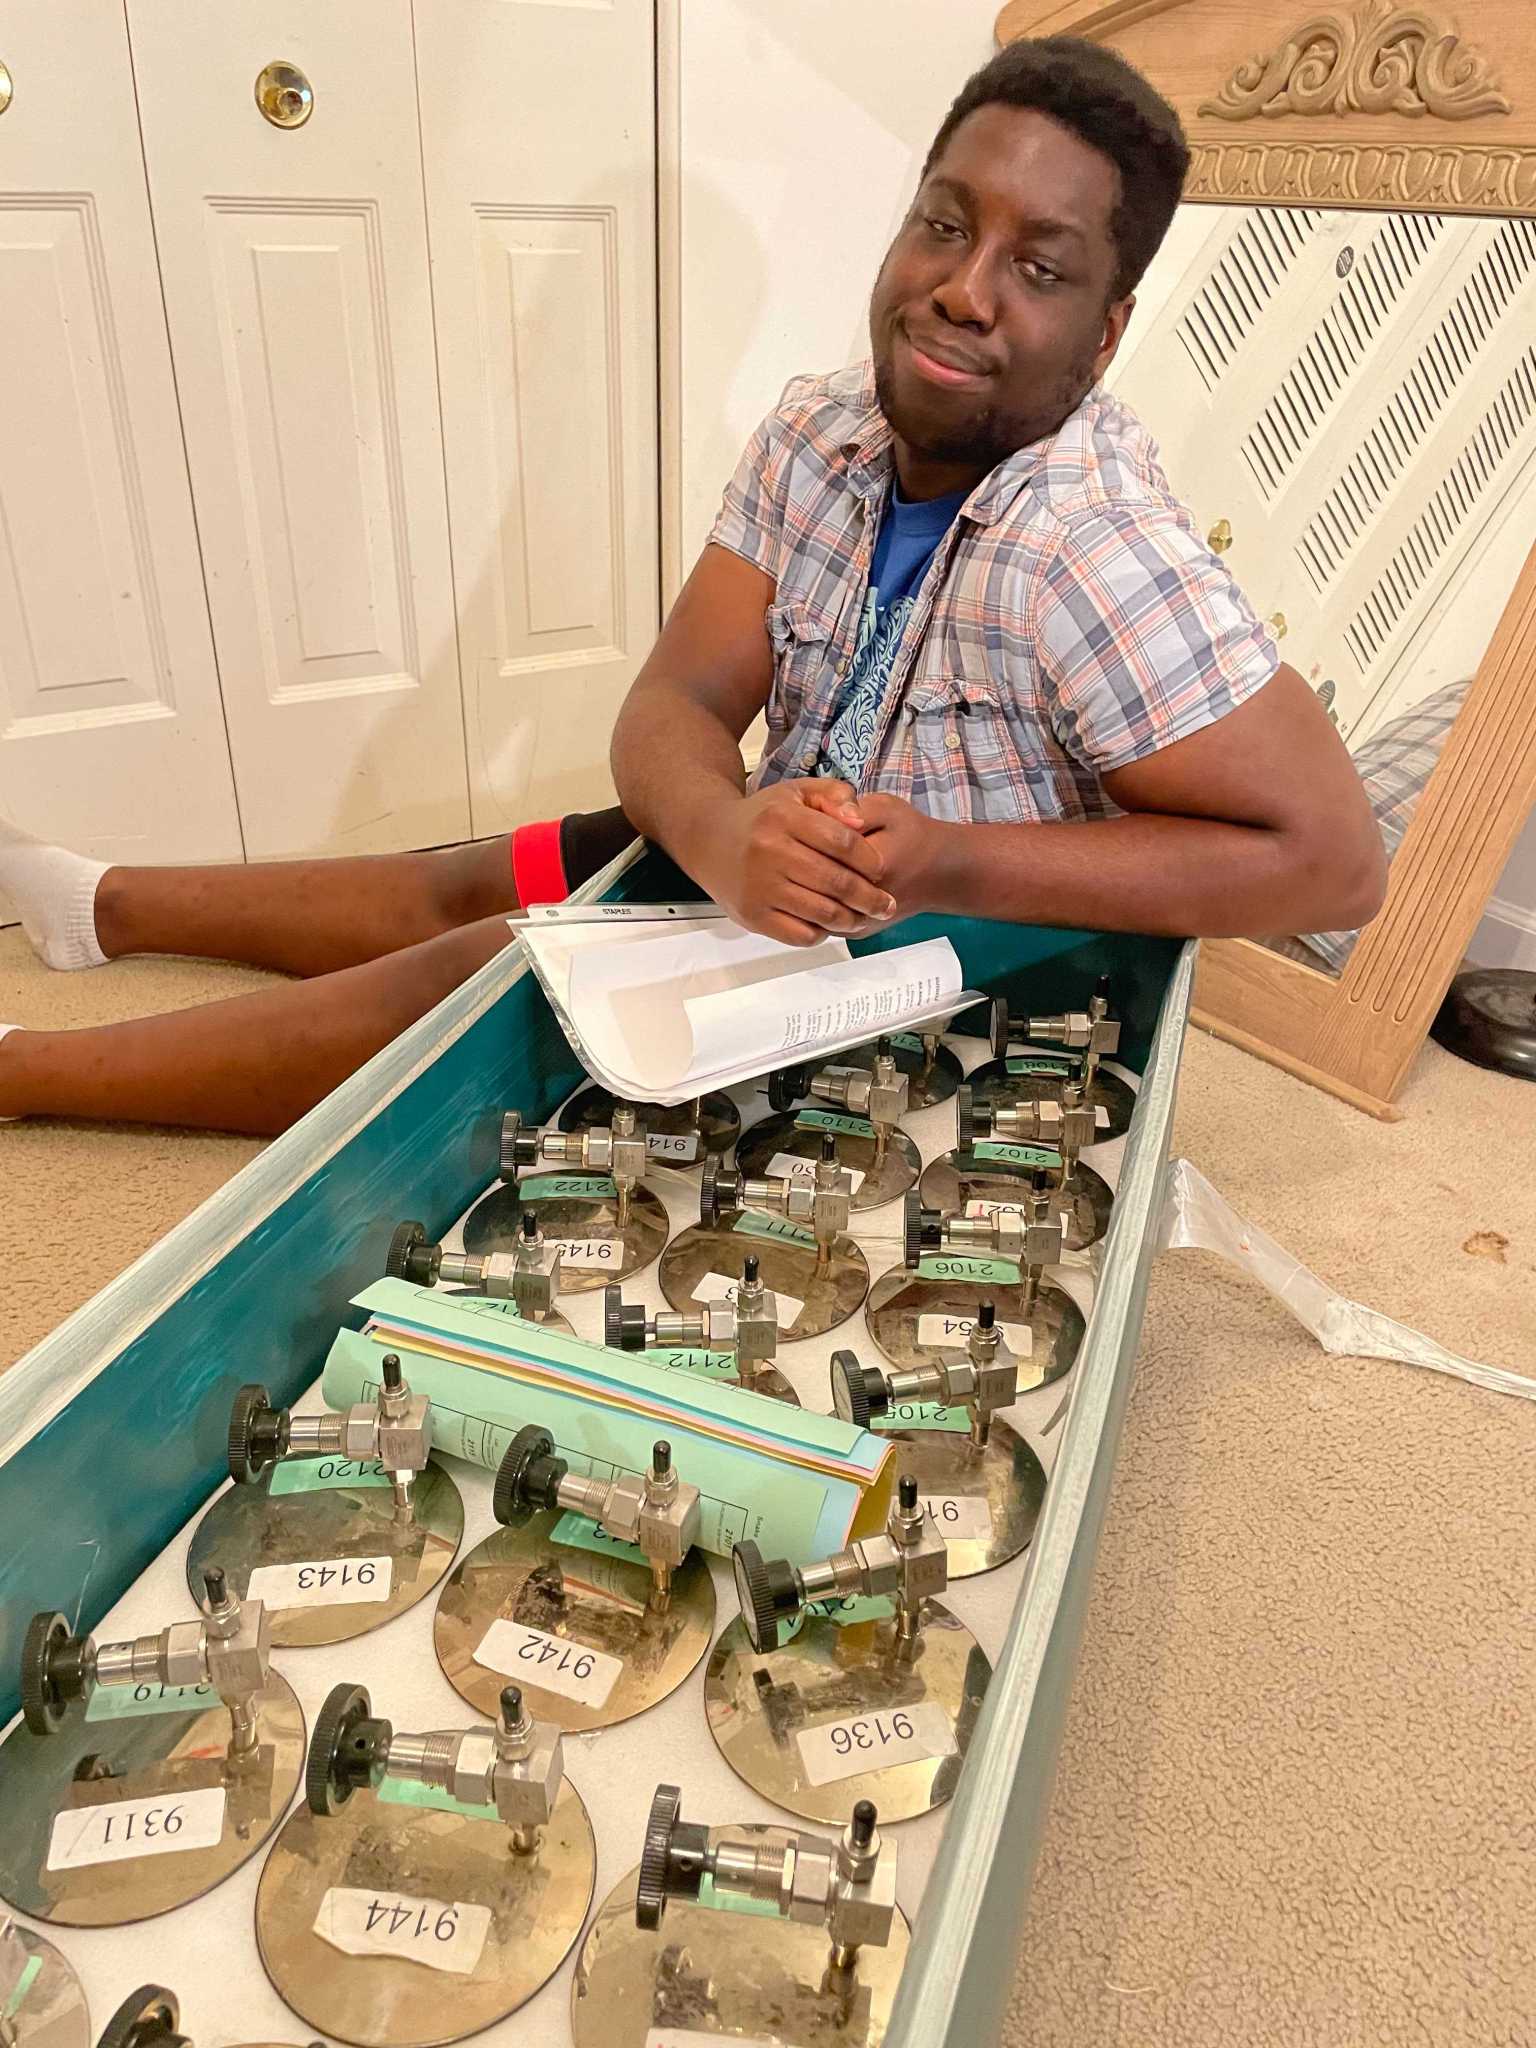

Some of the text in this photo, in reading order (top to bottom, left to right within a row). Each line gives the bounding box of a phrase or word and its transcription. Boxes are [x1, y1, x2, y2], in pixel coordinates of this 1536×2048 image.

[821, 1116, 872, 1133] 2110
[647, 1137, 687, 1151] 914
[995, 1146, 1047, 1162] 2107
[555, 1181, 609, 1192] 2122
[935, 1262, 993, 1276] 2106
[669, 1353, 732, 1369] 2112
[884, 1405, 948, 1422] 2105
[318, 1460, 385, 1479] 2120
[927, 1501, 959, 1521] 91
[298, 1563, 376, 1589] 9143
[518, 1634, 596, 1679] 9142
[830, 1713, 914, 1754] 9136
[103, 1804, 184, 1844] 9311
[366, 1899, 459, 1941] 9144
